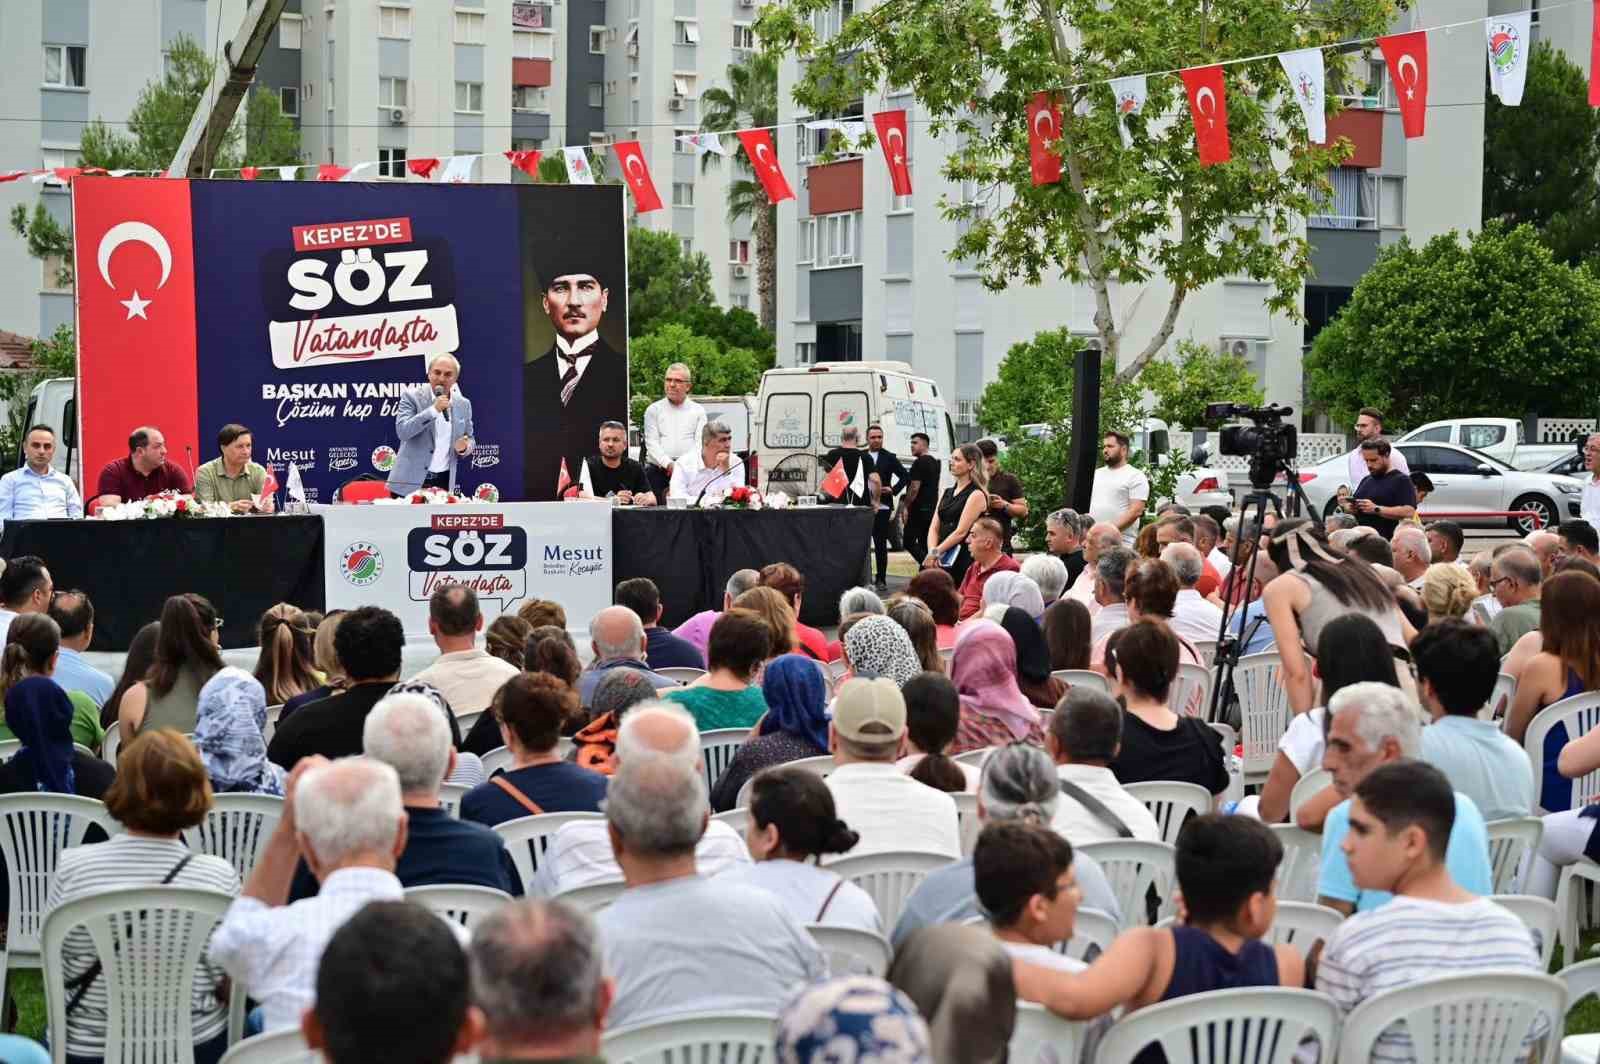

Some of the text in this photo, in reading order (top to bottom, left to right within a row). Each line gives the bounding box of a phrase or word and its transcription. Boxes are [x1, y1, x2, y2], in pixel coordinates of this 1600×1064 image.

[303, 222, 403, 246] KEPEZ'DE
[287, 248, 433, 311] SÖZ
[293, 313, 438, 362] Vatandaşta
[262, 383, 348, 401] BAŞKAN
[276, 394, 336, 428] Çözüm
[343, 400, 373, 422] hep
[266, 447, 316, 461] Mesut
[436, 516, 499, 528] KEPEZ'DE
[423, 530, 513, 567] SÖZ
[543, 545, 603, 561] Mesut
